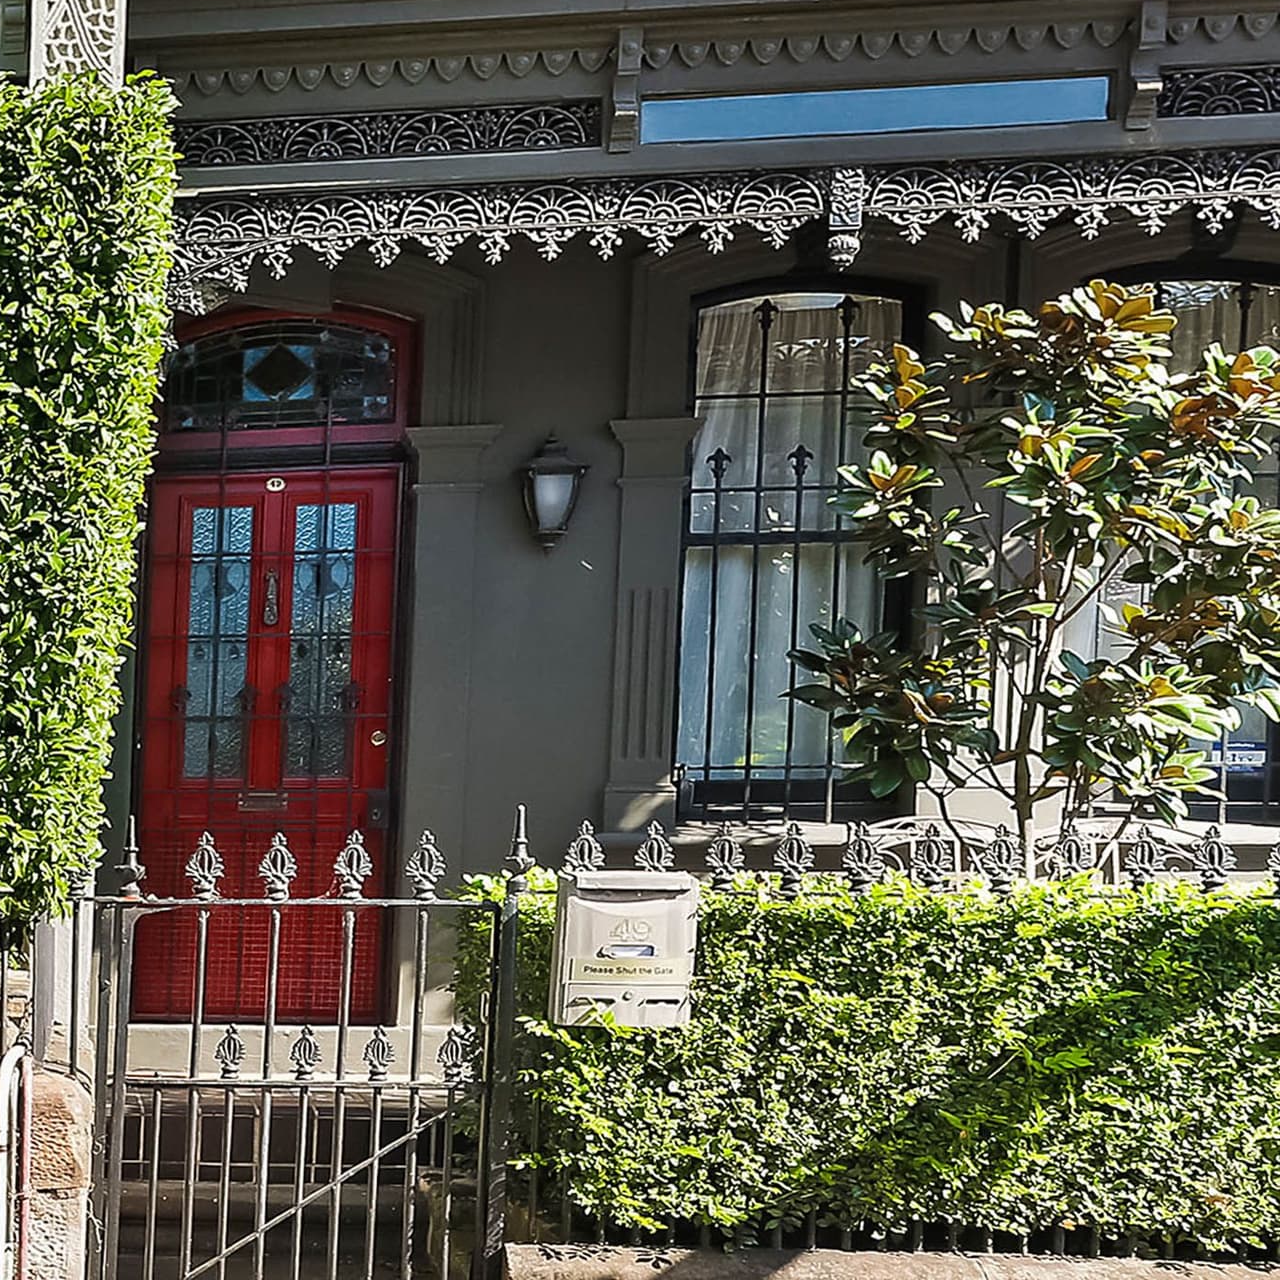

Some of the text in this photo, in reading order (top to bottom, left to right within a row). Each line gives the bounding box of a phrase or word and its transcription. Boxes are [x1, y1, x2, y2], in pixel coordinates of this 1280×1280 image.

[609, 919, 652, 942] 49
[583, 965, 673, 975] Please Shut the Gate
